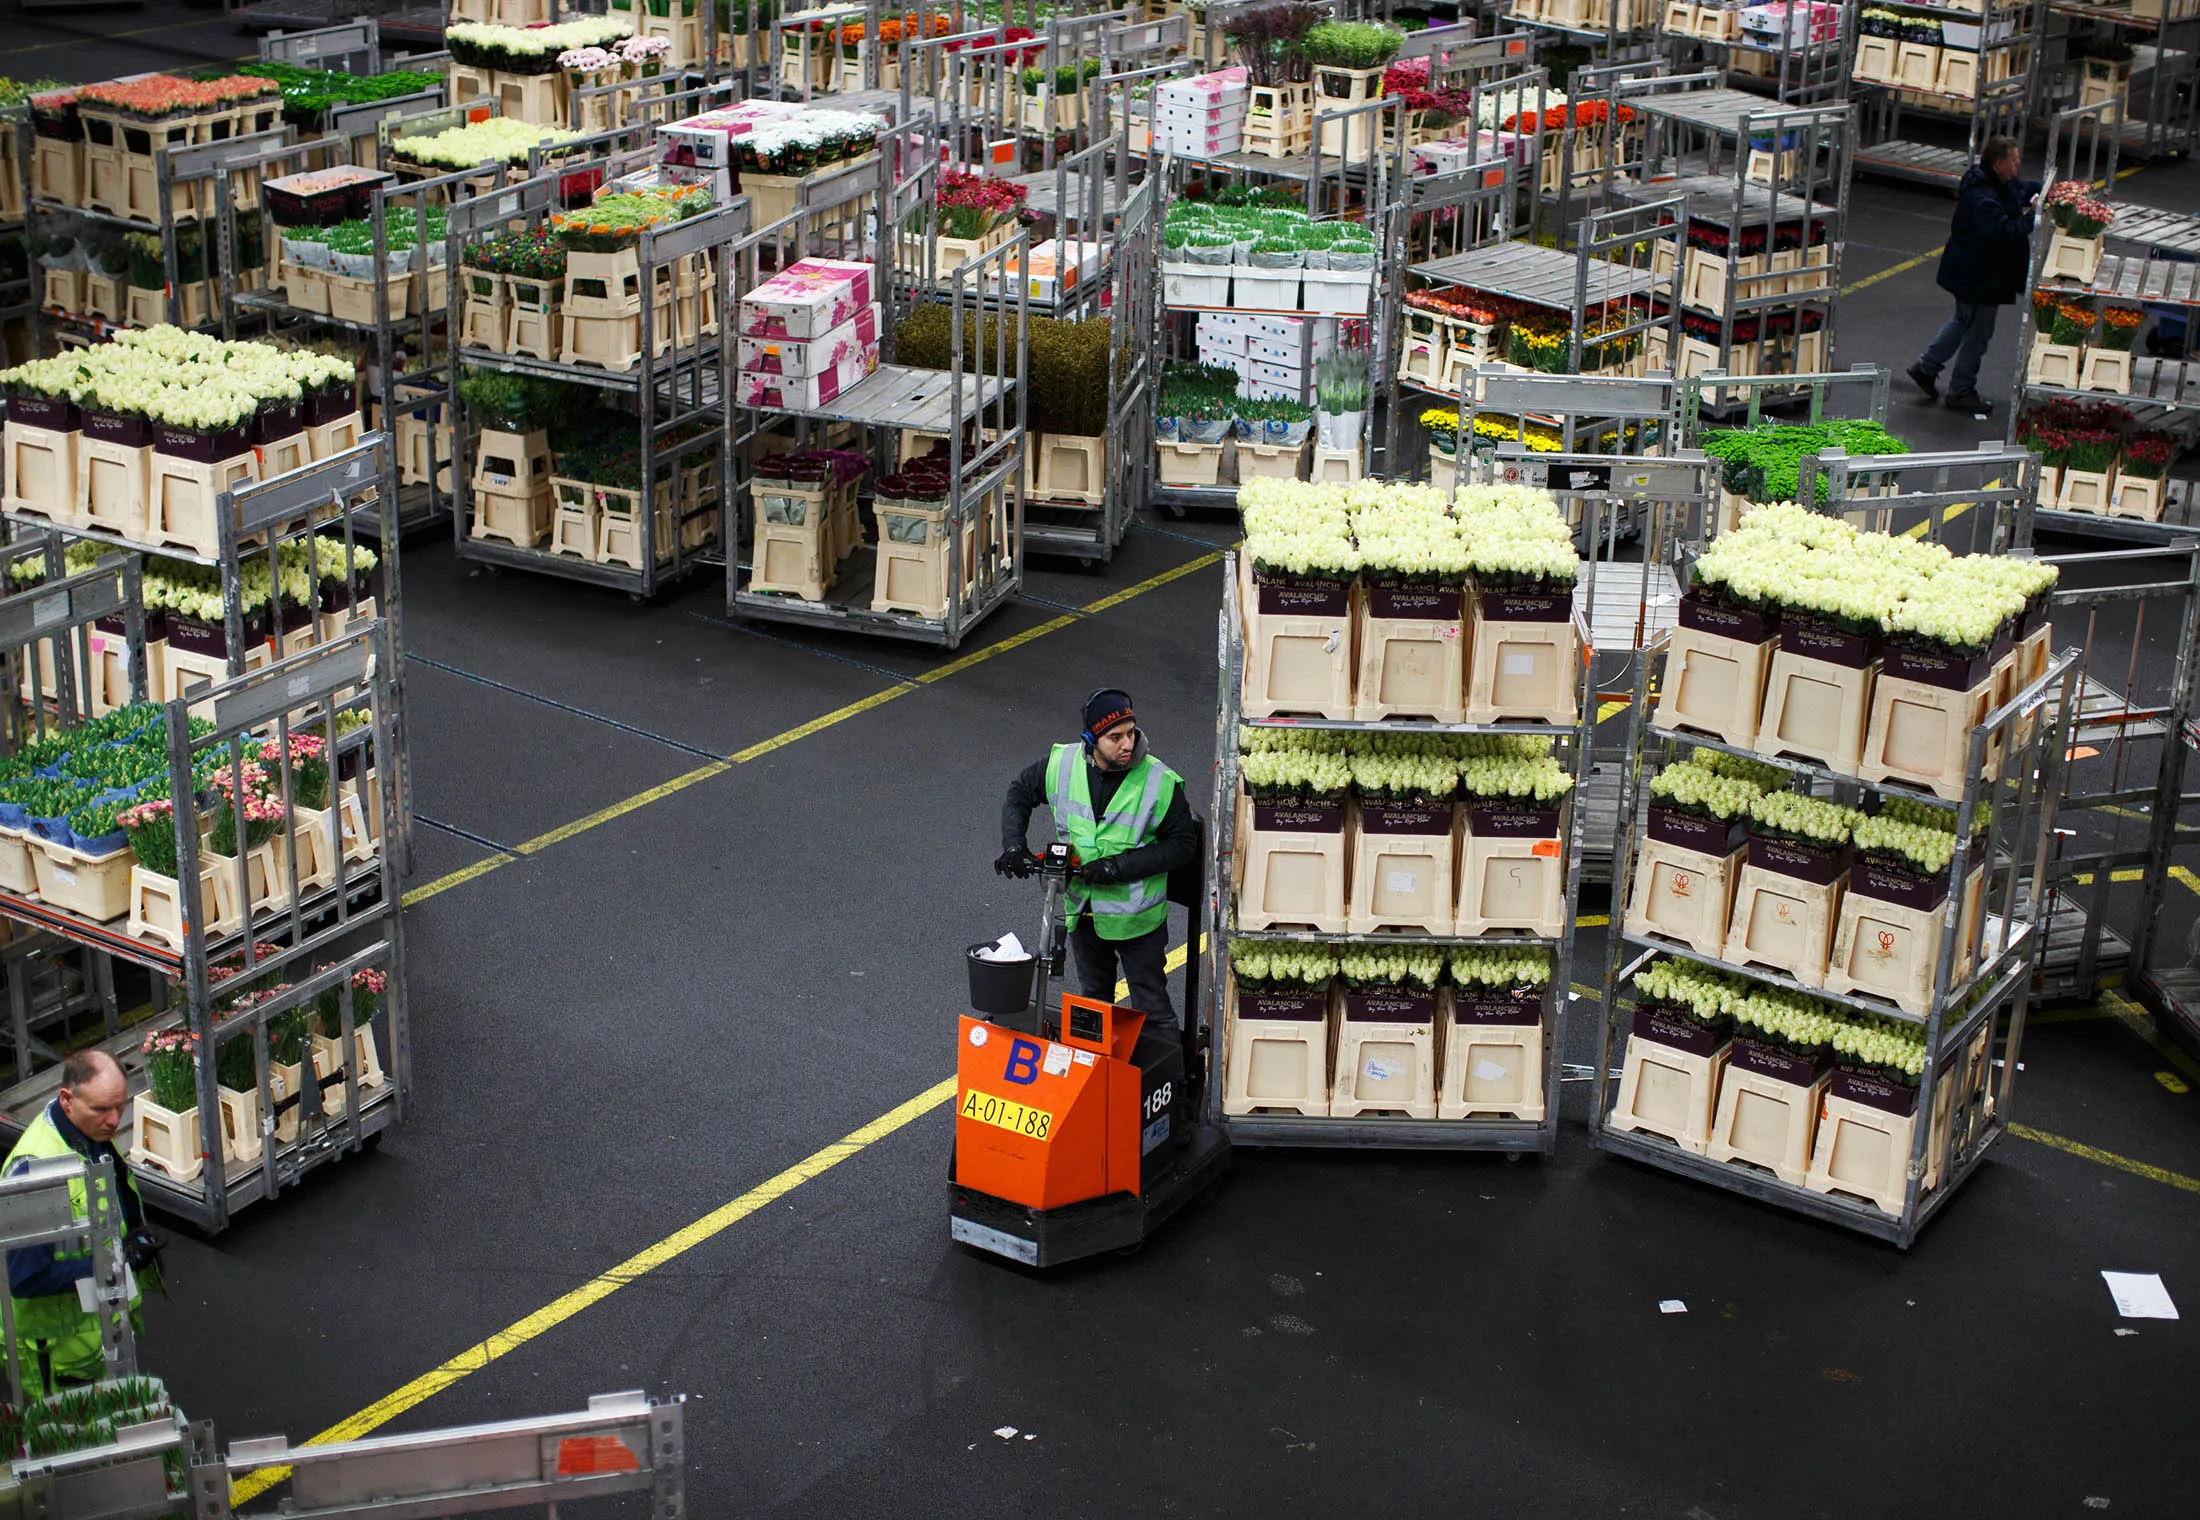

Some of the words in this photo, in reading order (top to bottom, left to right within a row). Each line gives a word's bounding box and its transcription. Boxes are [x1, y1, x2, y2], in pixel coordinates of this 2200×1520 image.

[1003, 1037, 1042, 1086] B
[962, 1092, 1051, 1139] A-01-188
[1143, 1081, 1172, 1120] 188
